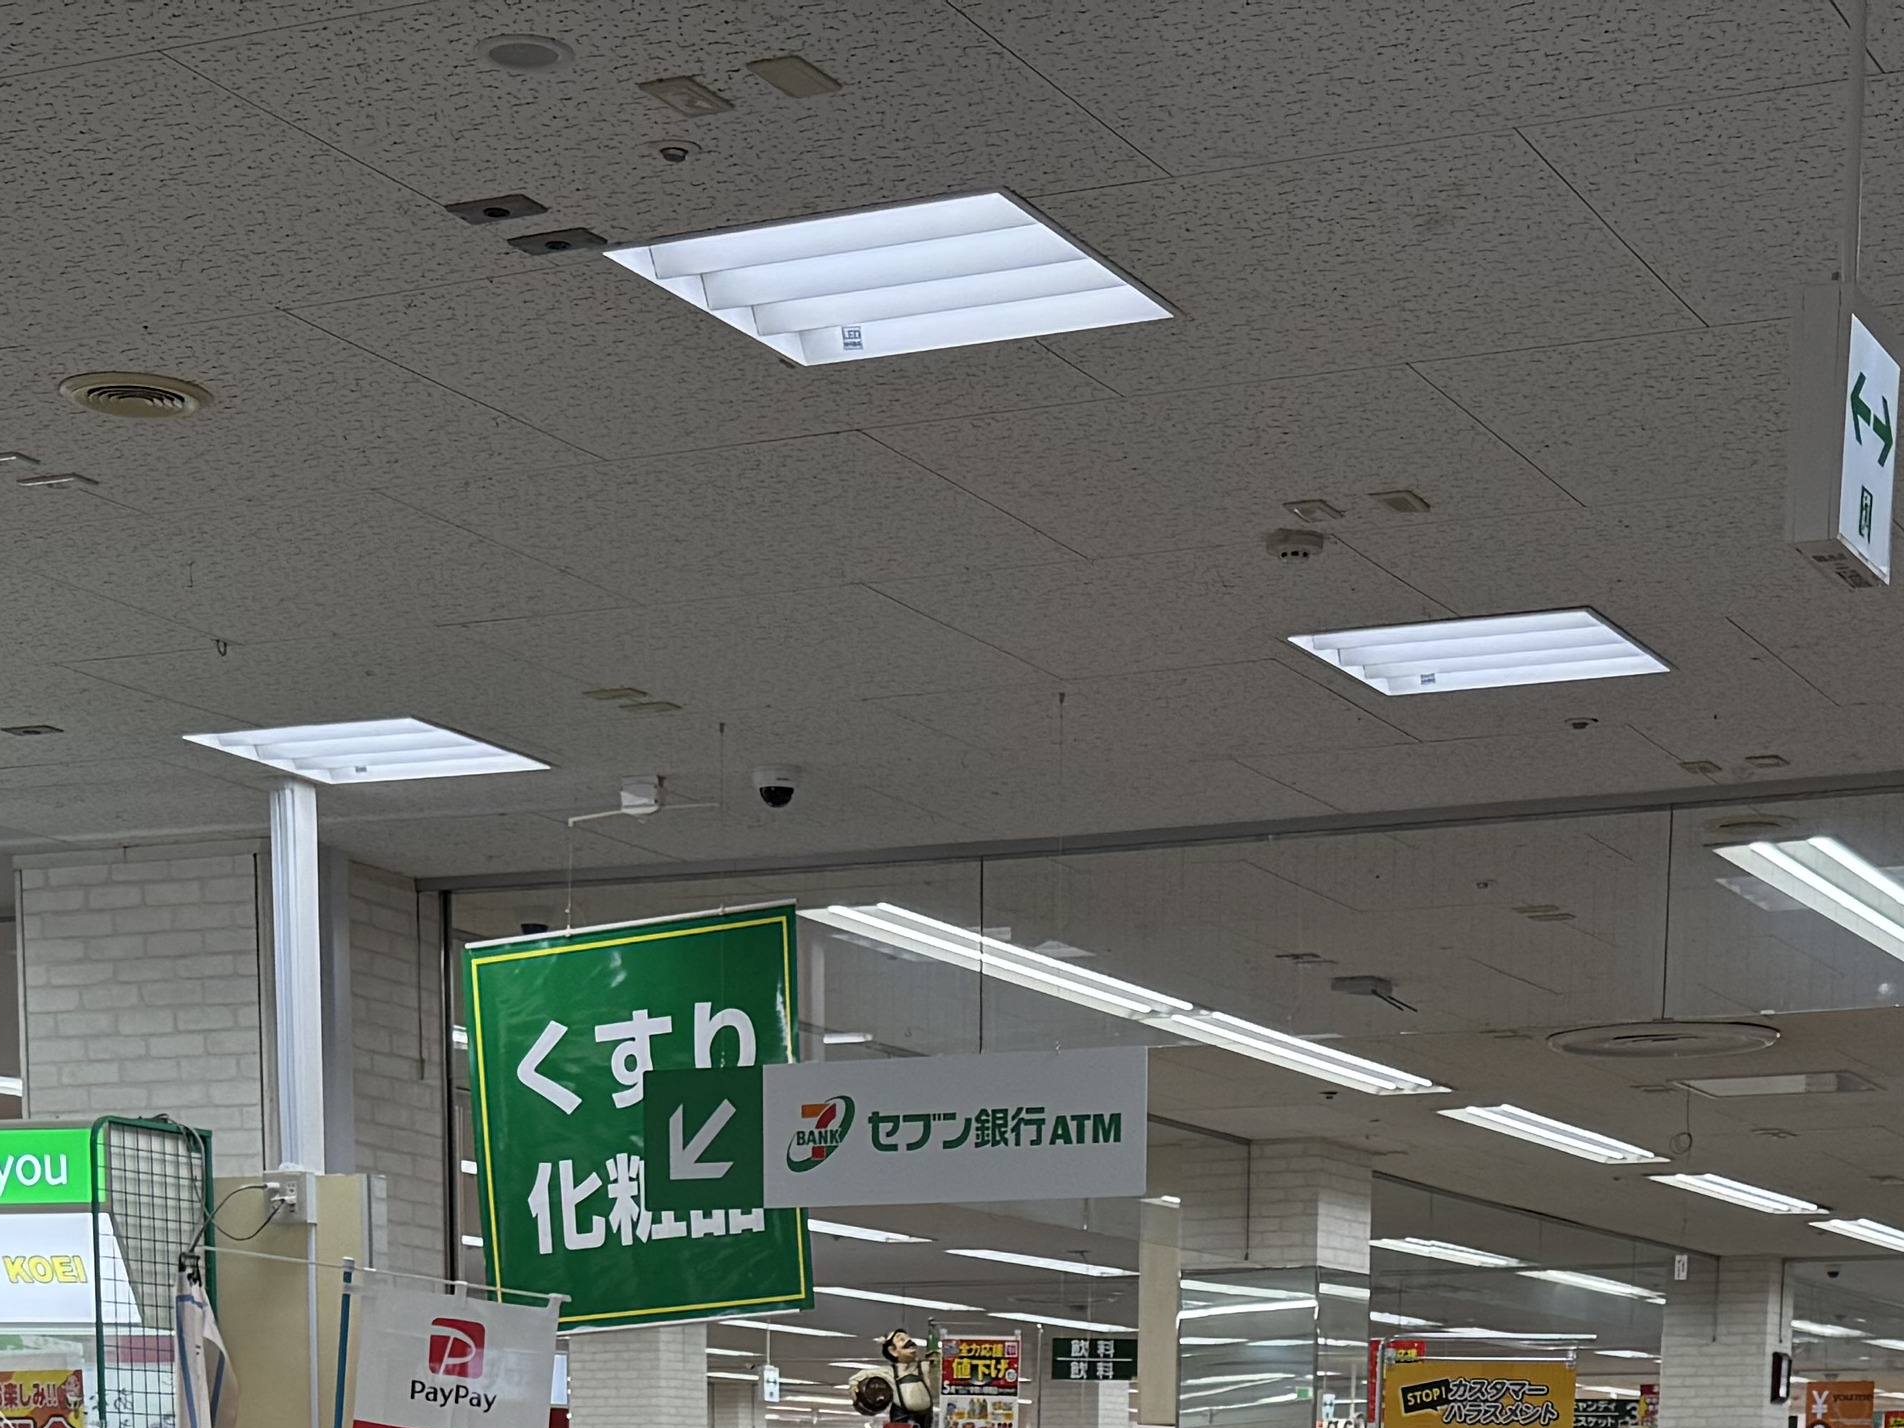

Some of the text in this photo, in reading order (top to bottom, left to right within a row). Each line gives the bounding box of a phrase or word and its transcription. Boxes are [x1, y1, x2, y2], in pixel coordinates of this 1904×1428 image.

[795, 1129, 842, 1147] BANK
[868, 1107, 1122, 1153] セブン銀行ATM
[4, 1253, 88, 1284] KOEI
[958, 1343, 1005, 1357] 全力応援
[1069, 1339, 1115, 1359] 飲料
[953, 1359, 1010, 1382] 値下げ
[1069, 1361, 1115, 1380] 飲料
[409, 1379, 497, 1414] PayPay
[1406, 1389, 1446, 1406] STOP!
[1448, 1378, 1549, 1400] カスタマー
[1443, 1402, 1560, 1426] ハラスメント
